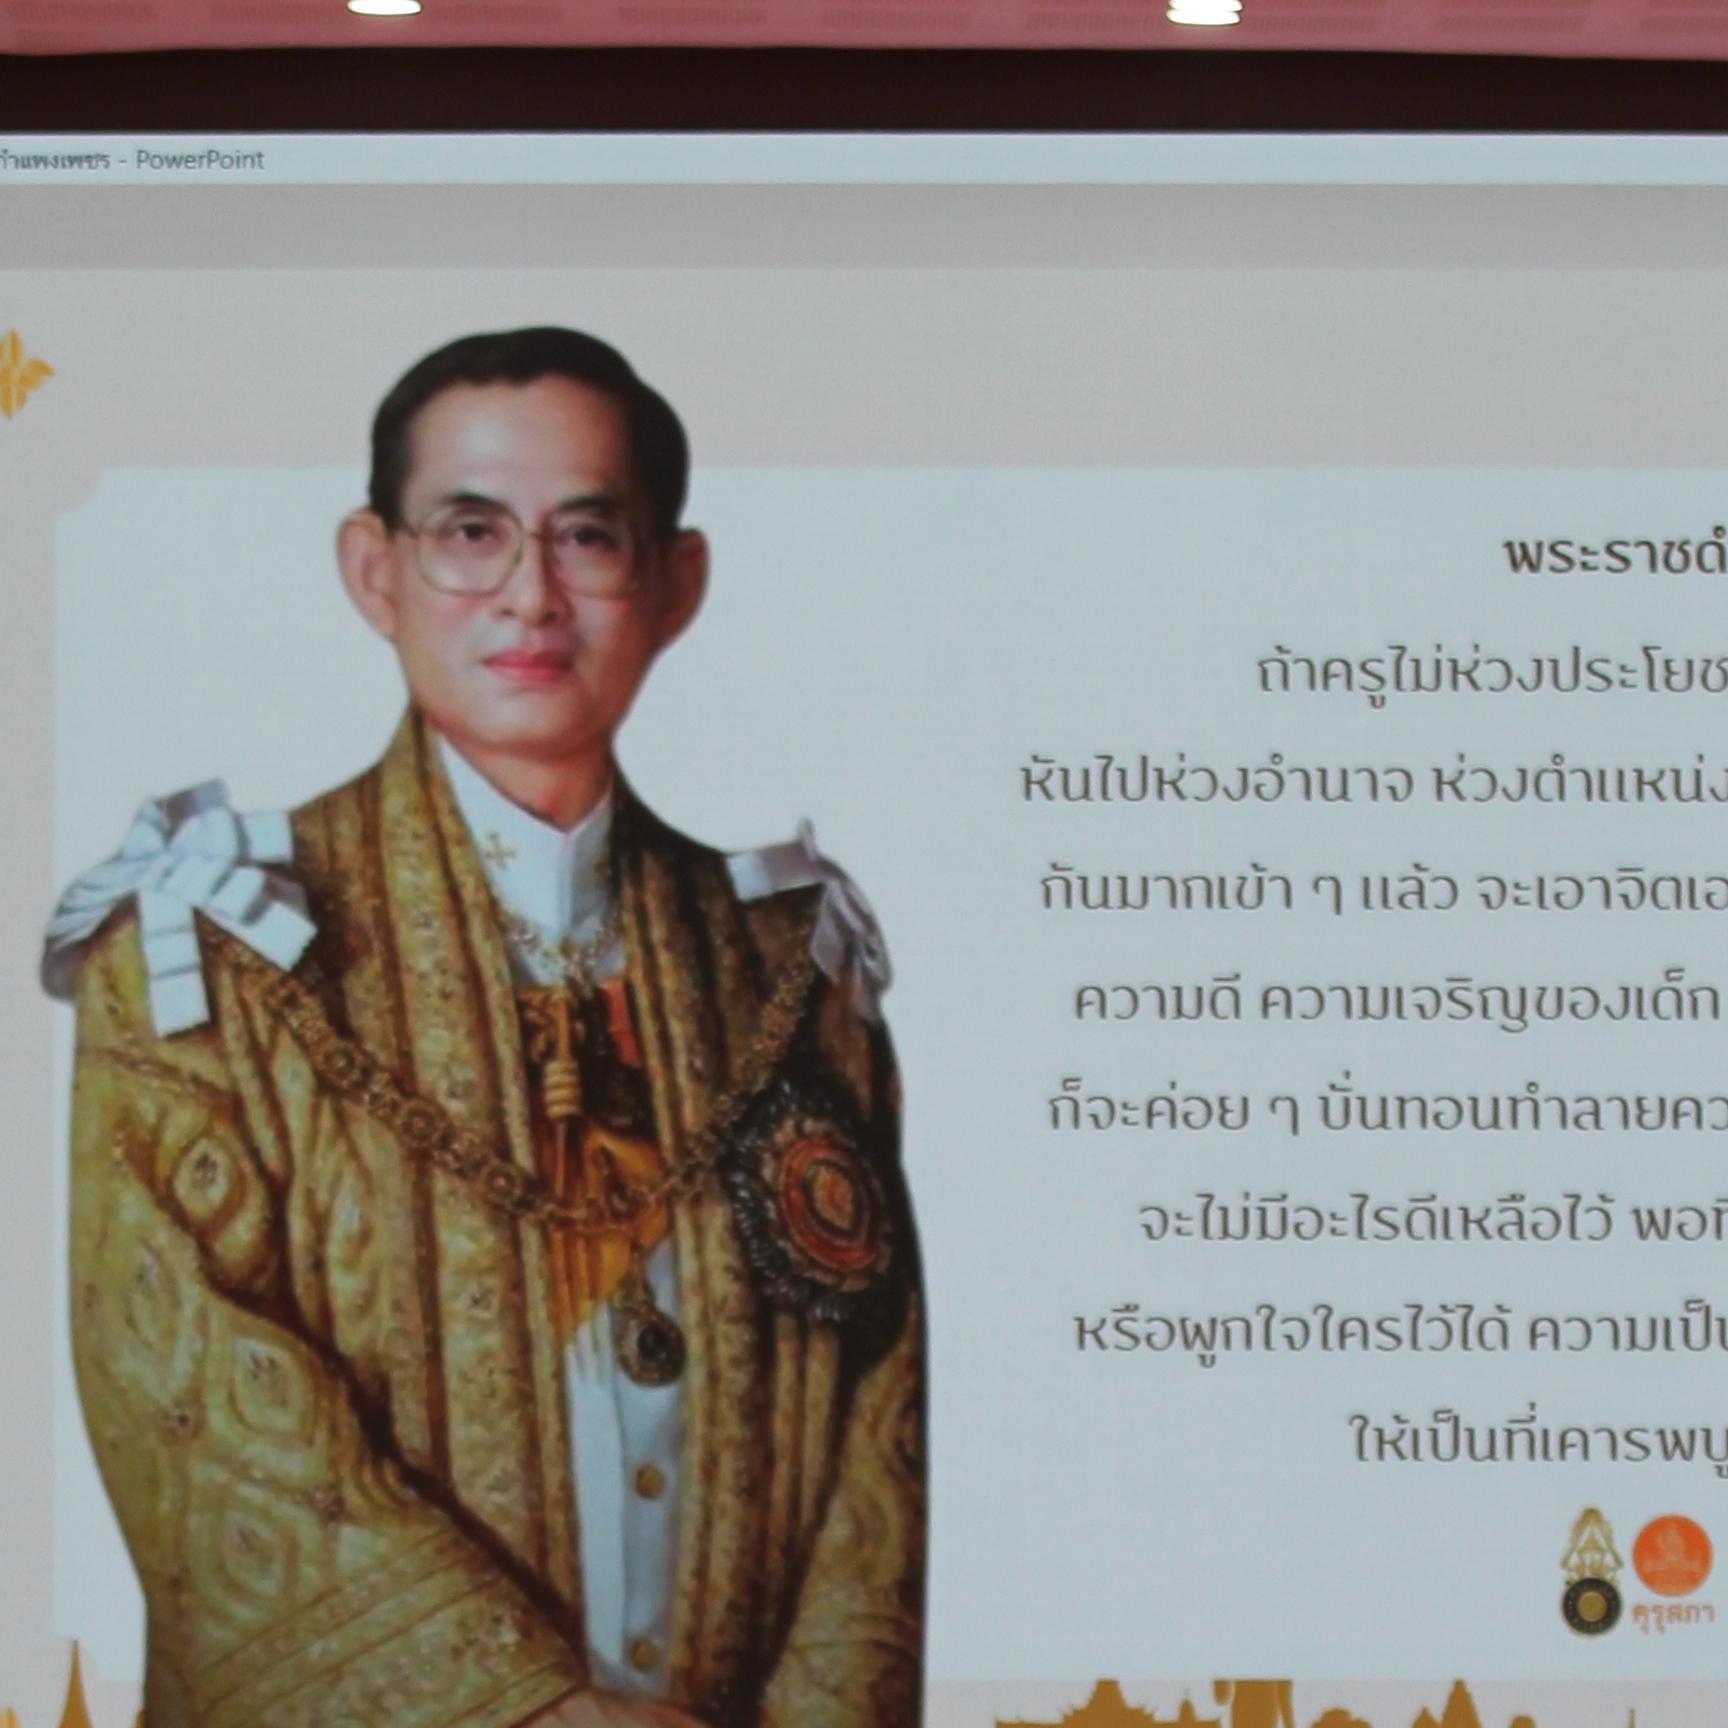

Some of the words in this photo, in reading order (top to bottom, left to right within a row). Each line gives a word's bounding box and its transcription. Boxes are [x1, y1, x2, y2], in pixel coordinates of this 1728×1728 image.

[137, 149, 266, 171] PowerPoint
[1021, 752, 1415, 804] หันไปห่วงอำนาจ
[1041, 862, 1294, 911] กันมากเข้า
[1312, 875, 1344, 917] ๆ
[1362, 863, 1460, 912] แล้ว
[1075, 972, 1243, 1021] ความดี
[1261, 968, 1721, 1035] ความเจริญของเด็ก
[1048, 1077, 1251, 1132] ก็จะค่อย
[1269, 1096, 1300, 1138] ๆ
[1140, 1191, 1616, 1242] จะไม่มีอะไรดีเหลือไว้
[1074, 1303, 1513, 1370] หรือผูกใจใครไว้ได้
[1632, 1603, 1716, 1635] คุรุสภา
